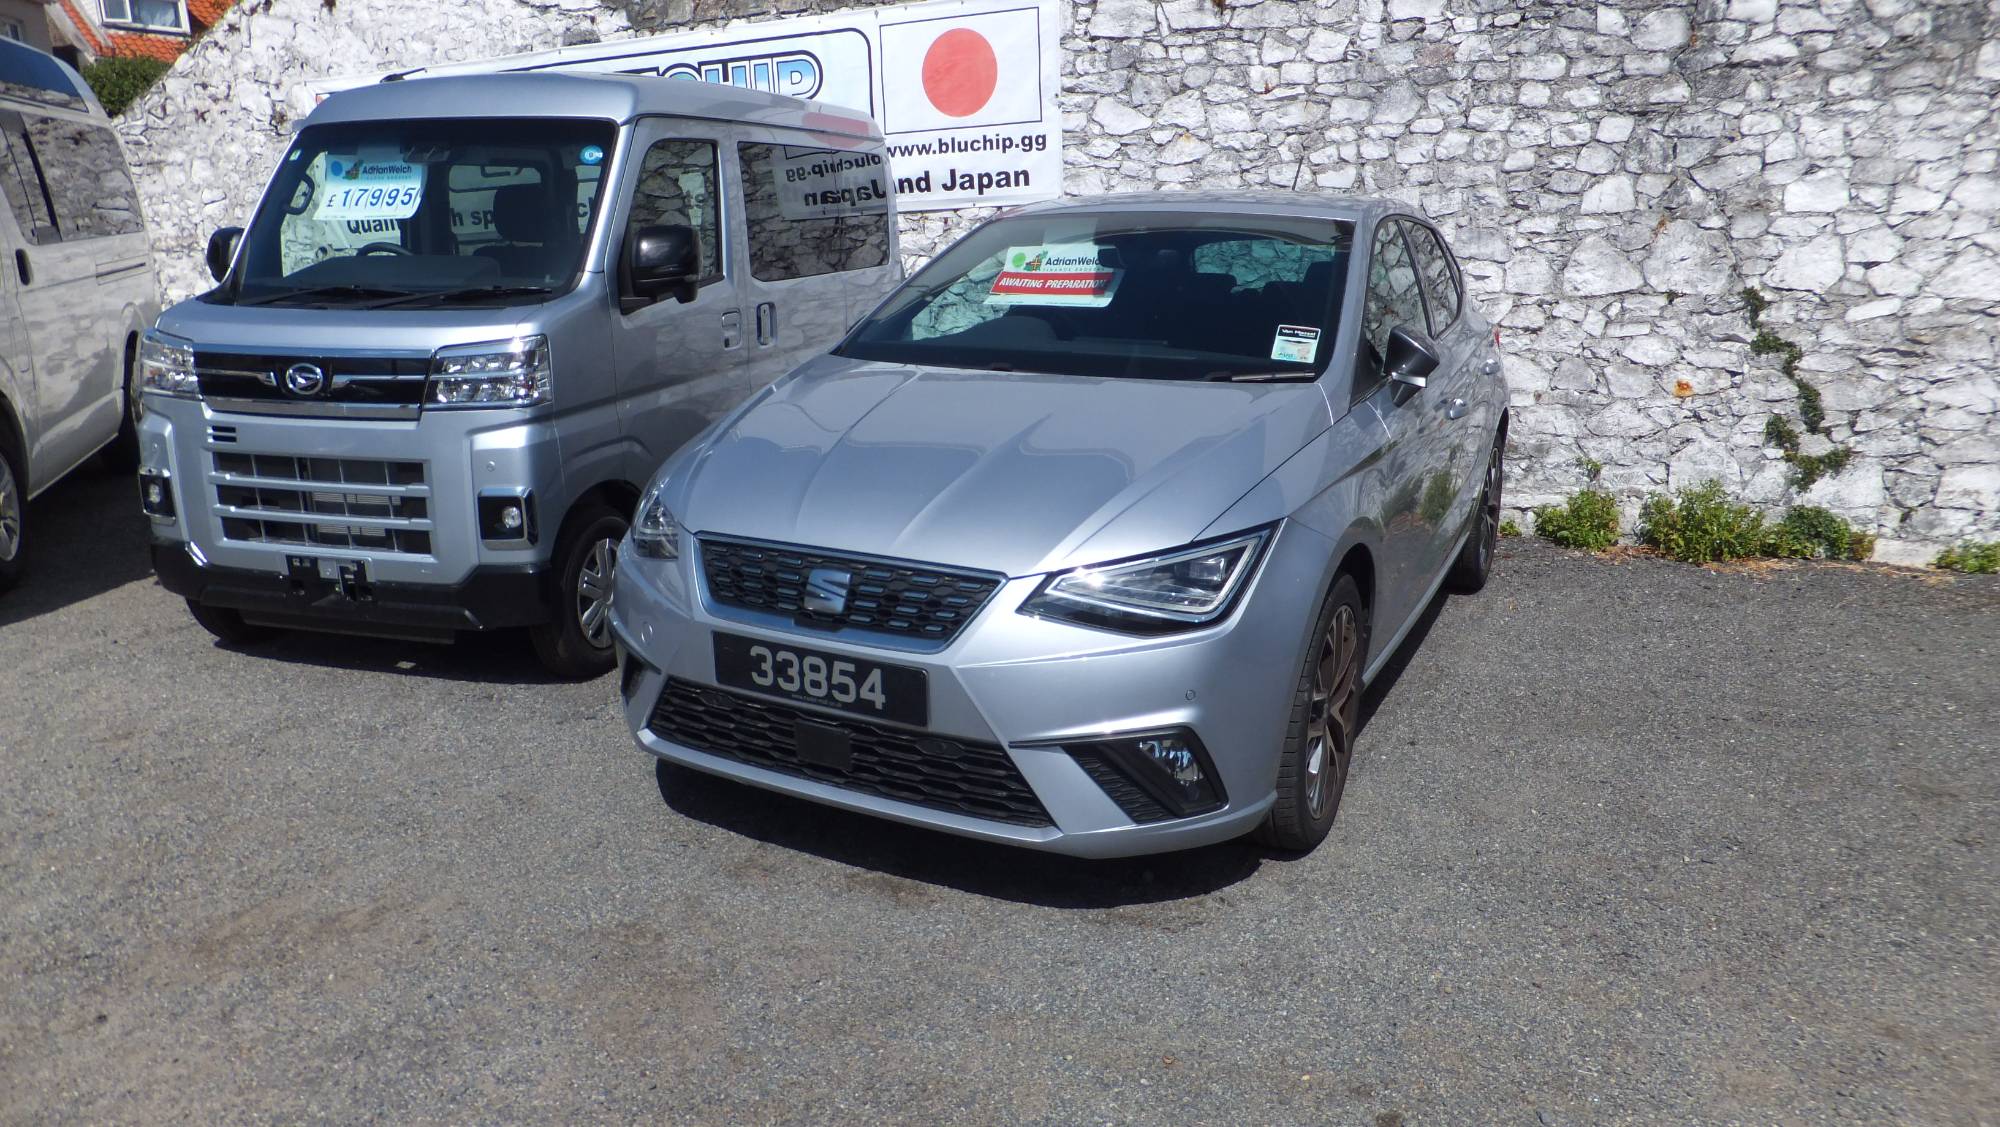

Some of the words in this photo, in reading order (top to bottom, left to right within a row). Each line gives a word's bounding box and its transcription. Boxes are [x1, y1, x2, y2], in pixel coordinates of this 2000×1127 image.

[886, 133, 1047, 158] www.bluchip.gg
[893, 170, 931, 194] nd
[942, 168, 1030, 196] Japan
[1045, 256, 1101, 267] AdrianWelc
[998, 277, 1044, 288] AWAITING
[1044, 279, 1106, 289] PREPARATION
[750, 645, 886, 710] 33854
